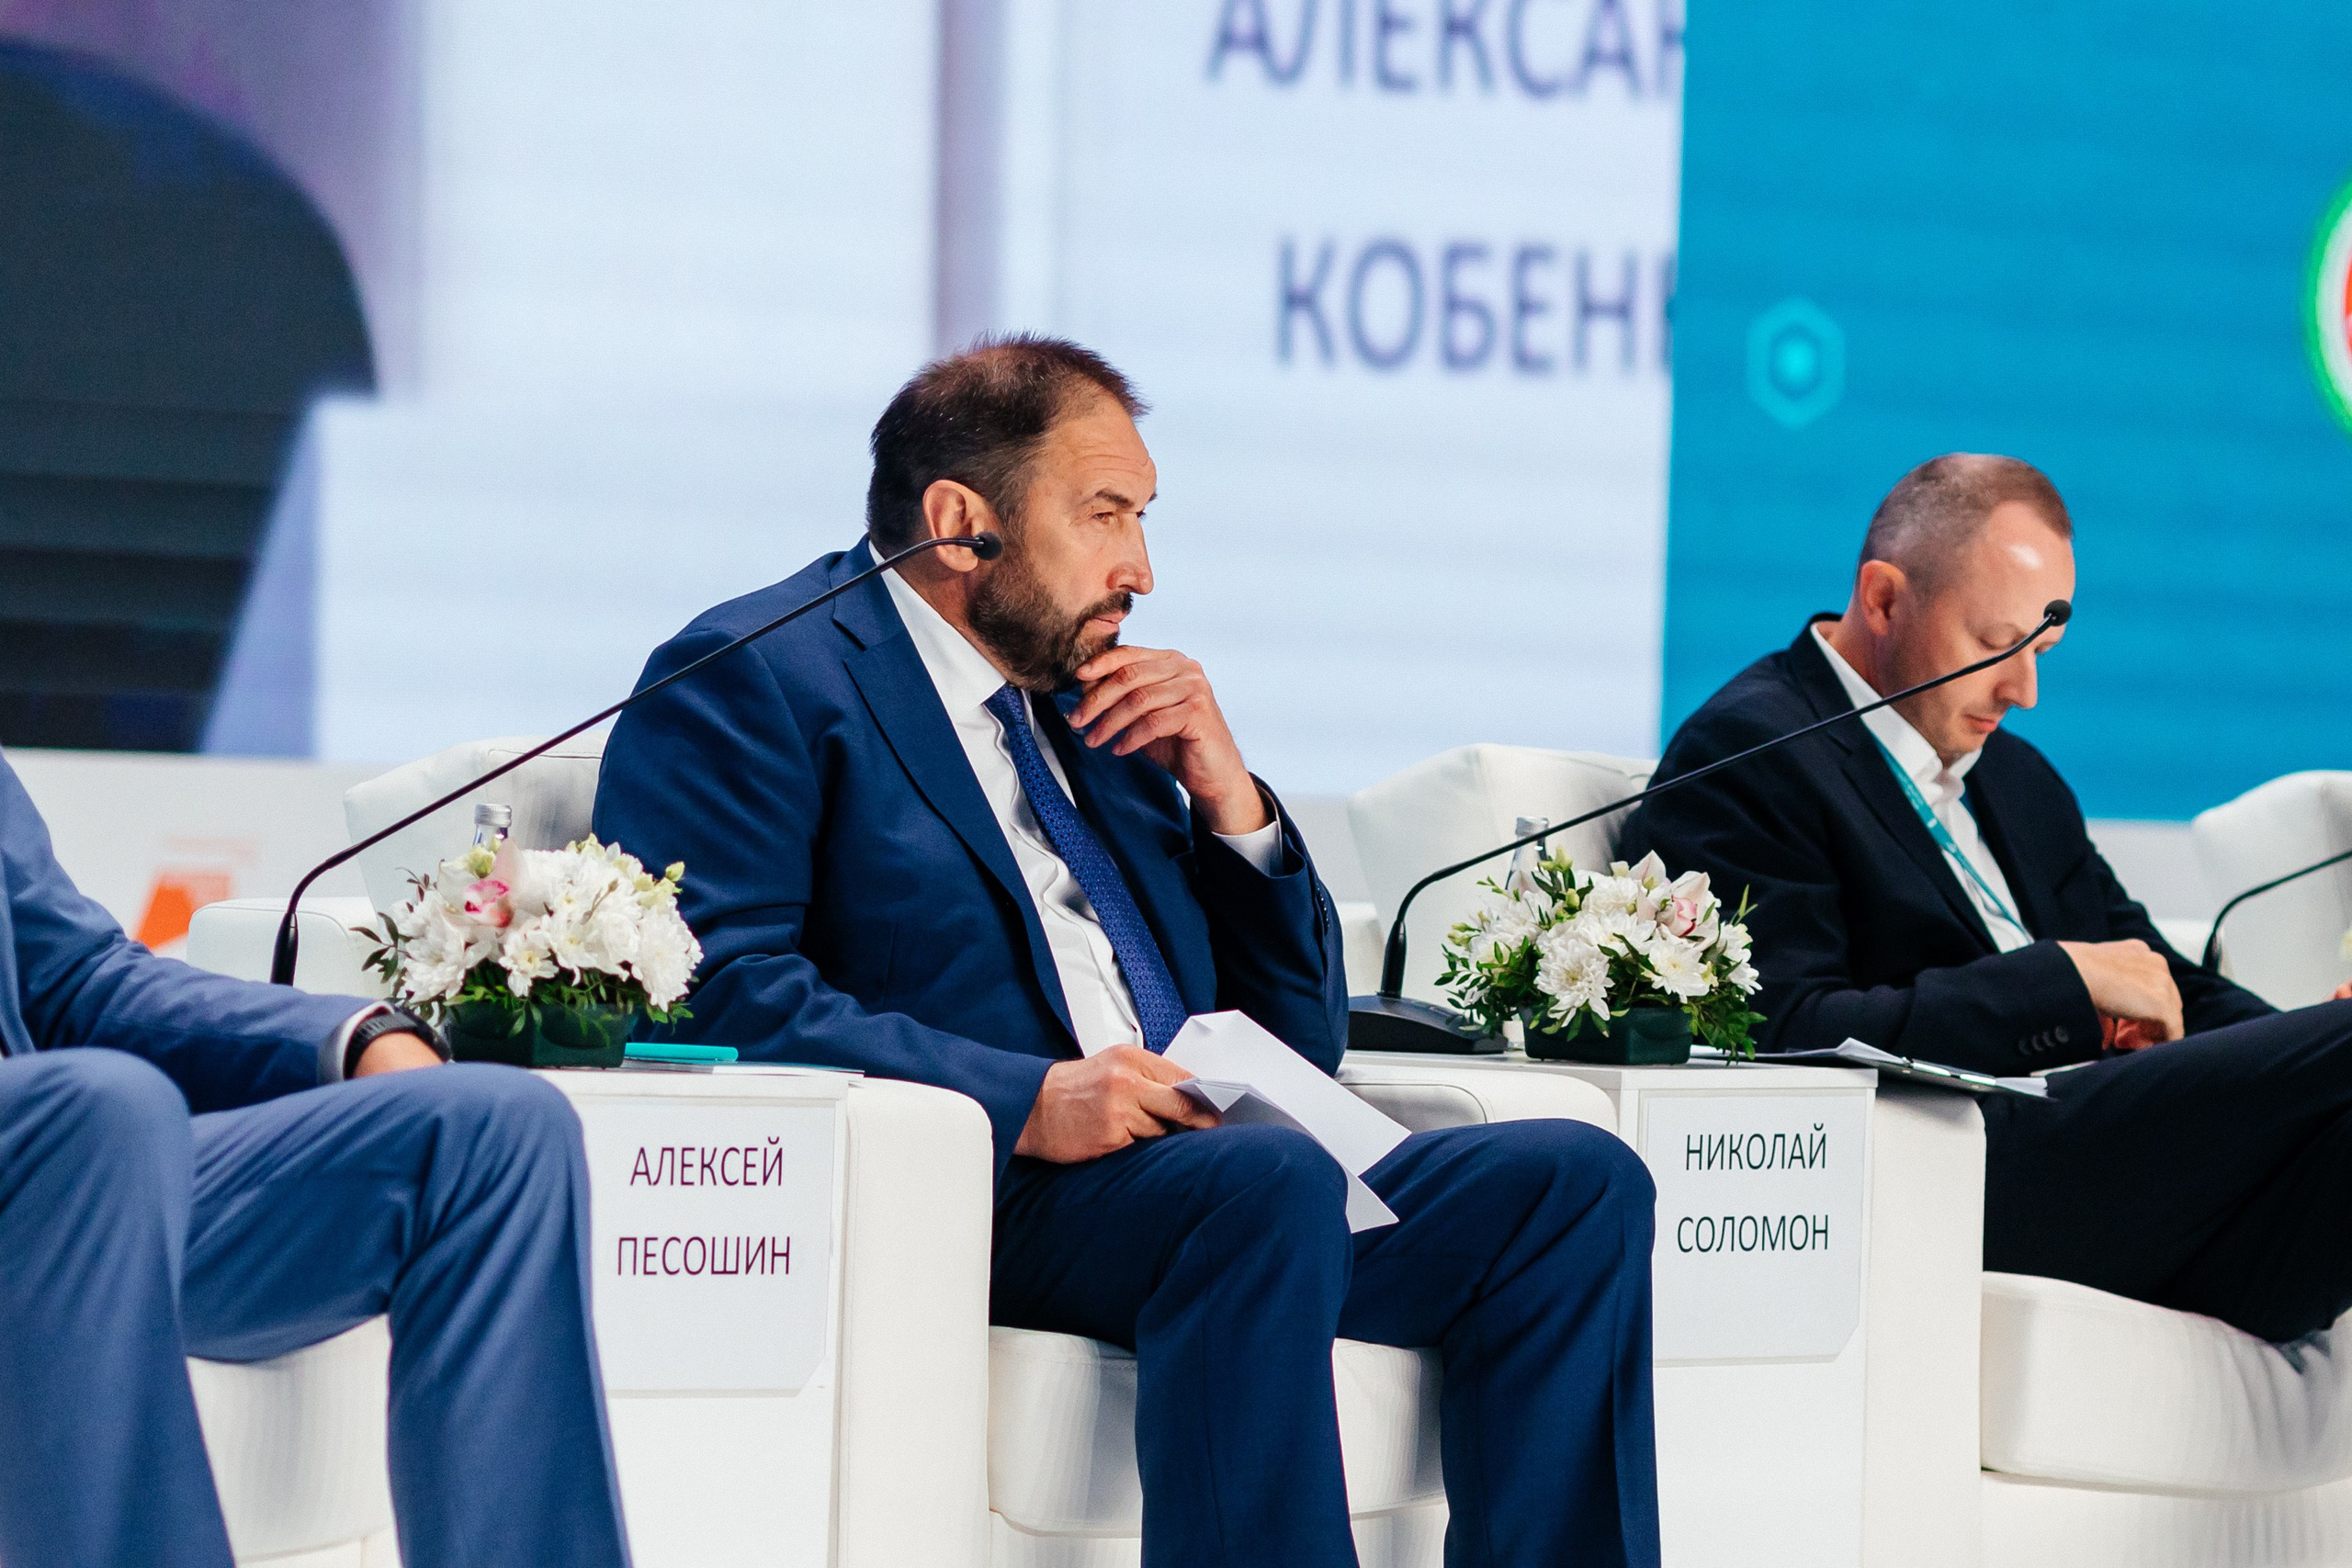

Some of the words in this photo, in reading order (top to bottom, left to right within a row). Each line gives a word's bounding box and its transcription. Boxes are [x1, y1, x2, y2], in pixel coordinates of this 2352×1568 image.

[629, 1135, 784, 1187] АЛЕКСЕЙ
[1686, 1122, 1826, 1170] НИКОЛАЙ
[616, 1235, 791, 1276] ПЕСОШИН
[1677, 1214, 1828, 1253] СОЛОМОН
